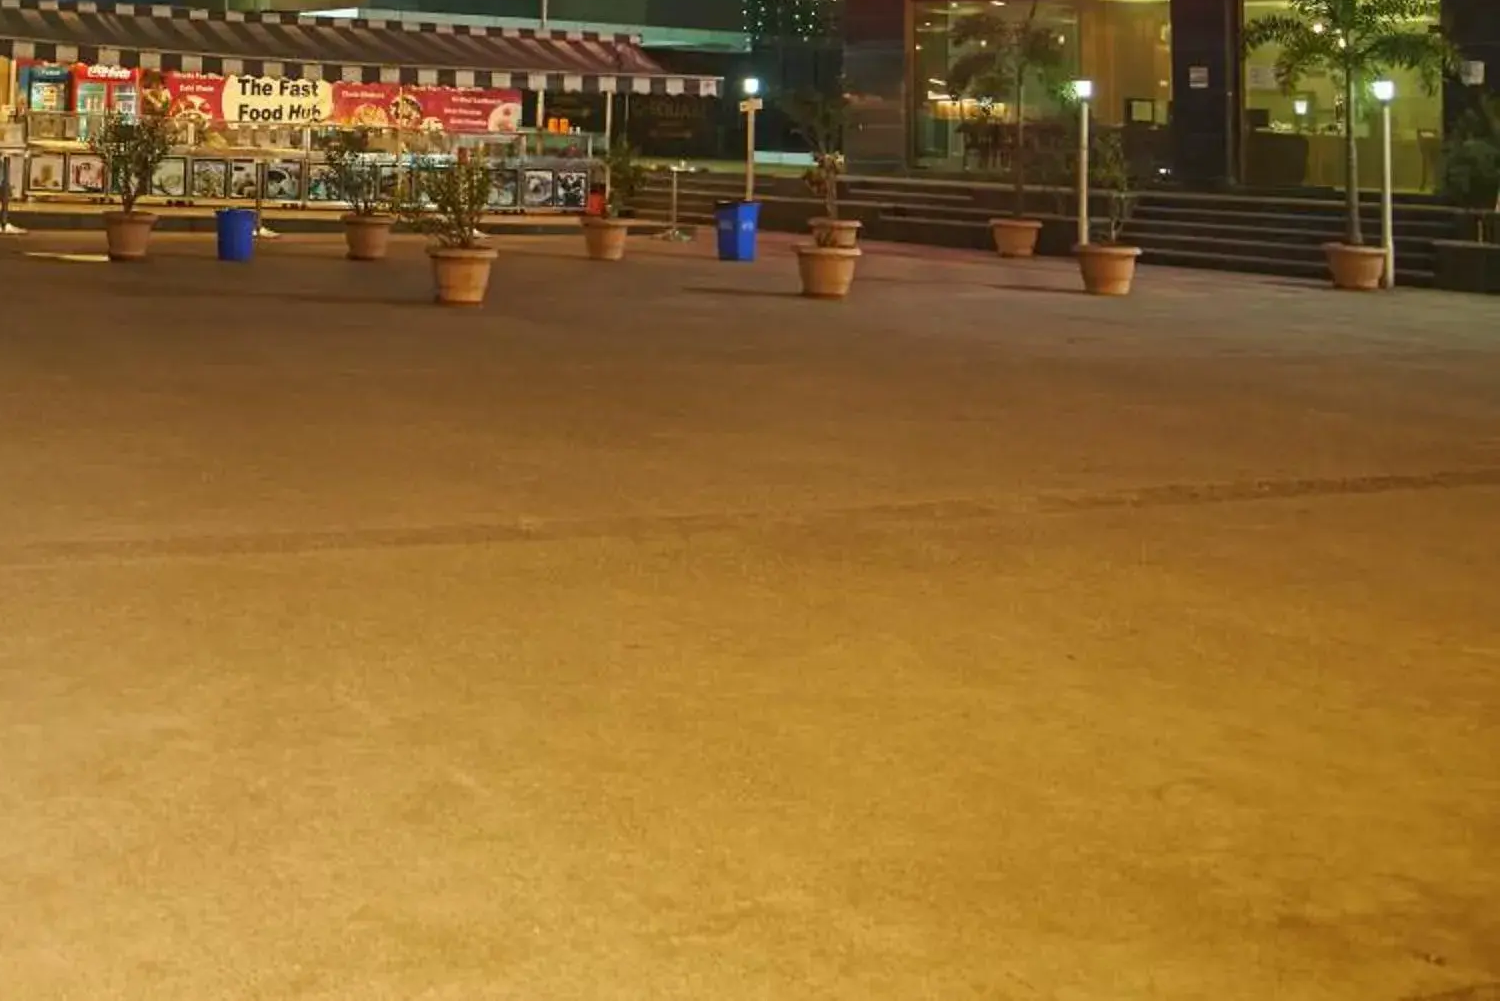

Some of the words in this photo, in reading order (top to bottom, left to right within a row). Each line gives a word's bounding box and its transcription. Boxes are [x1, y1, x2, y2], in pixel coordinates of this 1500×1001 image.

[238, 79, 273, 97] The
[279, 80, 319, 98] Fast
[238, 104, 284, 122] Food
[288, 104, 322, 122] Hub
